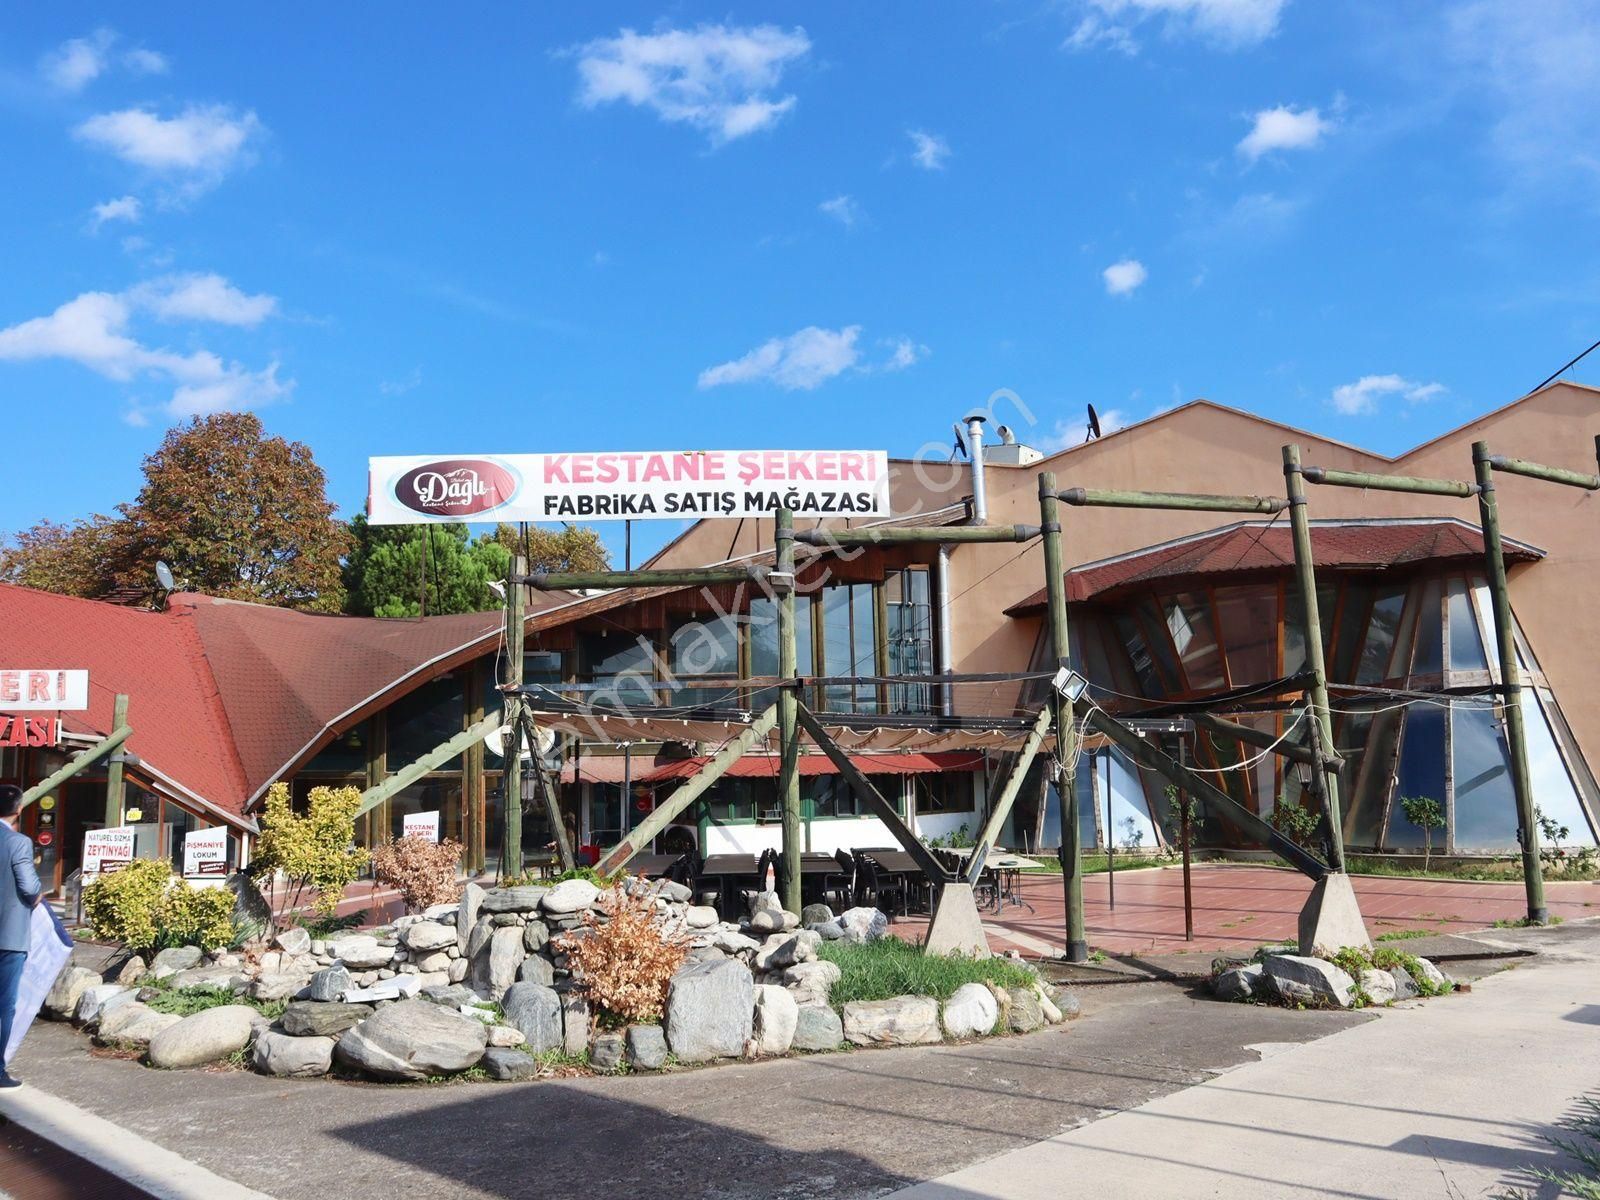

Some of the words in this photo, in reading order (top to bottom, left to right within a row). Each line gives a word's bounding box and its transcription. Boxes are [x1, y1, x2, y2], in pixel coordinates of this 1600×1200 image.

[544, 452, 725, 483] KESTANE
[664, 492, 736, 515] SATIŞ
[744, 486, 878, 513] MAĞAZASI
[192, 851, 218, 859] LOKUM
